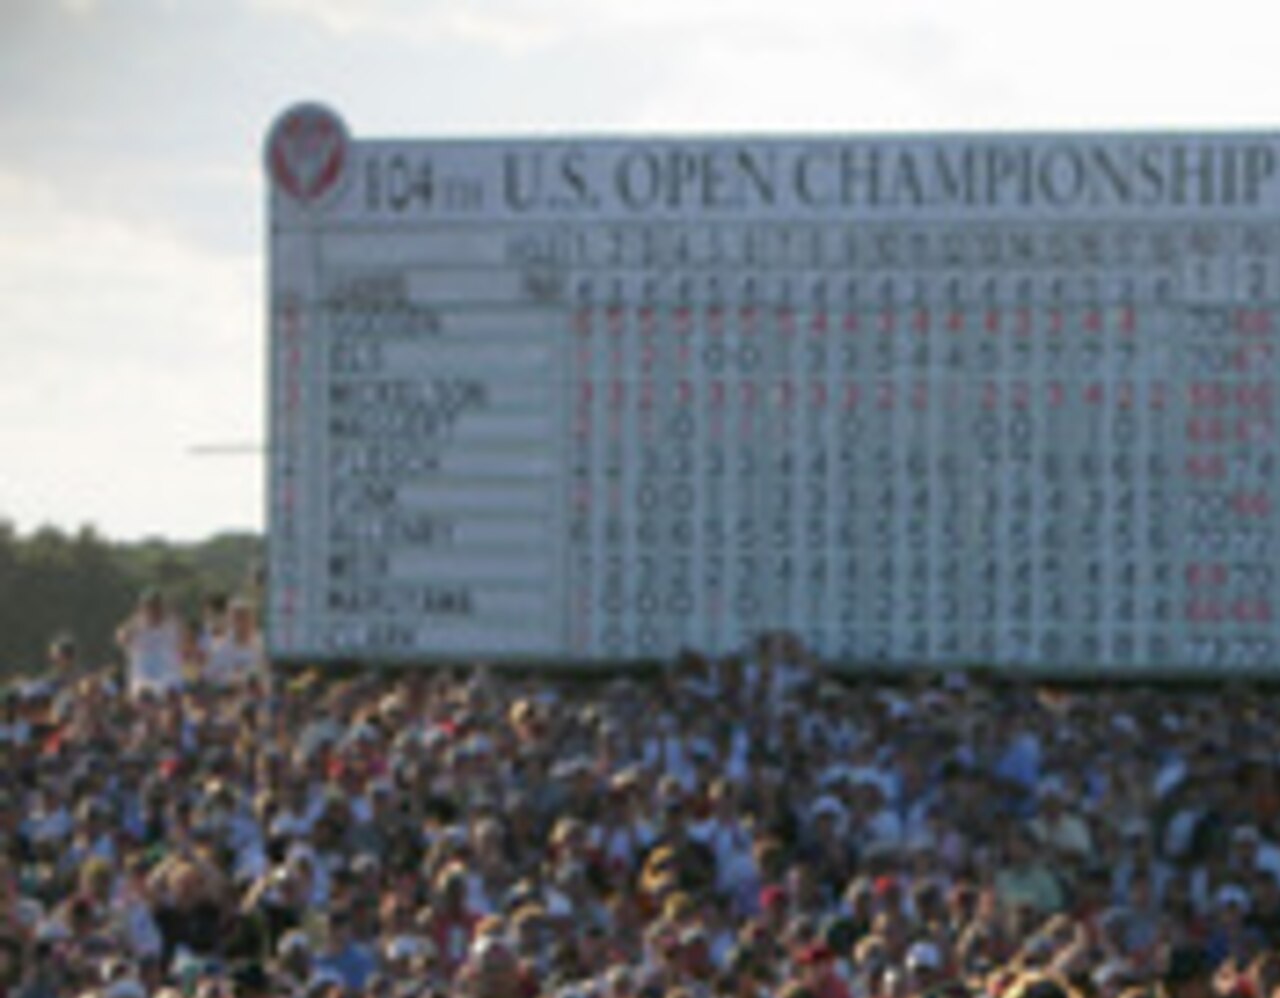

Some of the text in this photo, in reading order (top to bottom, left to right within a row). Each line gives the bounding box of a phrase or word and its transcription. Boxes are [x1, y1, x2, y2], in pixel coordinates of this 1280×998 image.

[504, 150, 600, 208] U.S.
[615, 148, 776, 207] OPEN
[794, 142, 1276, 207] CHAMPIONSHIP
[331, 342, 384, 372] ELS
